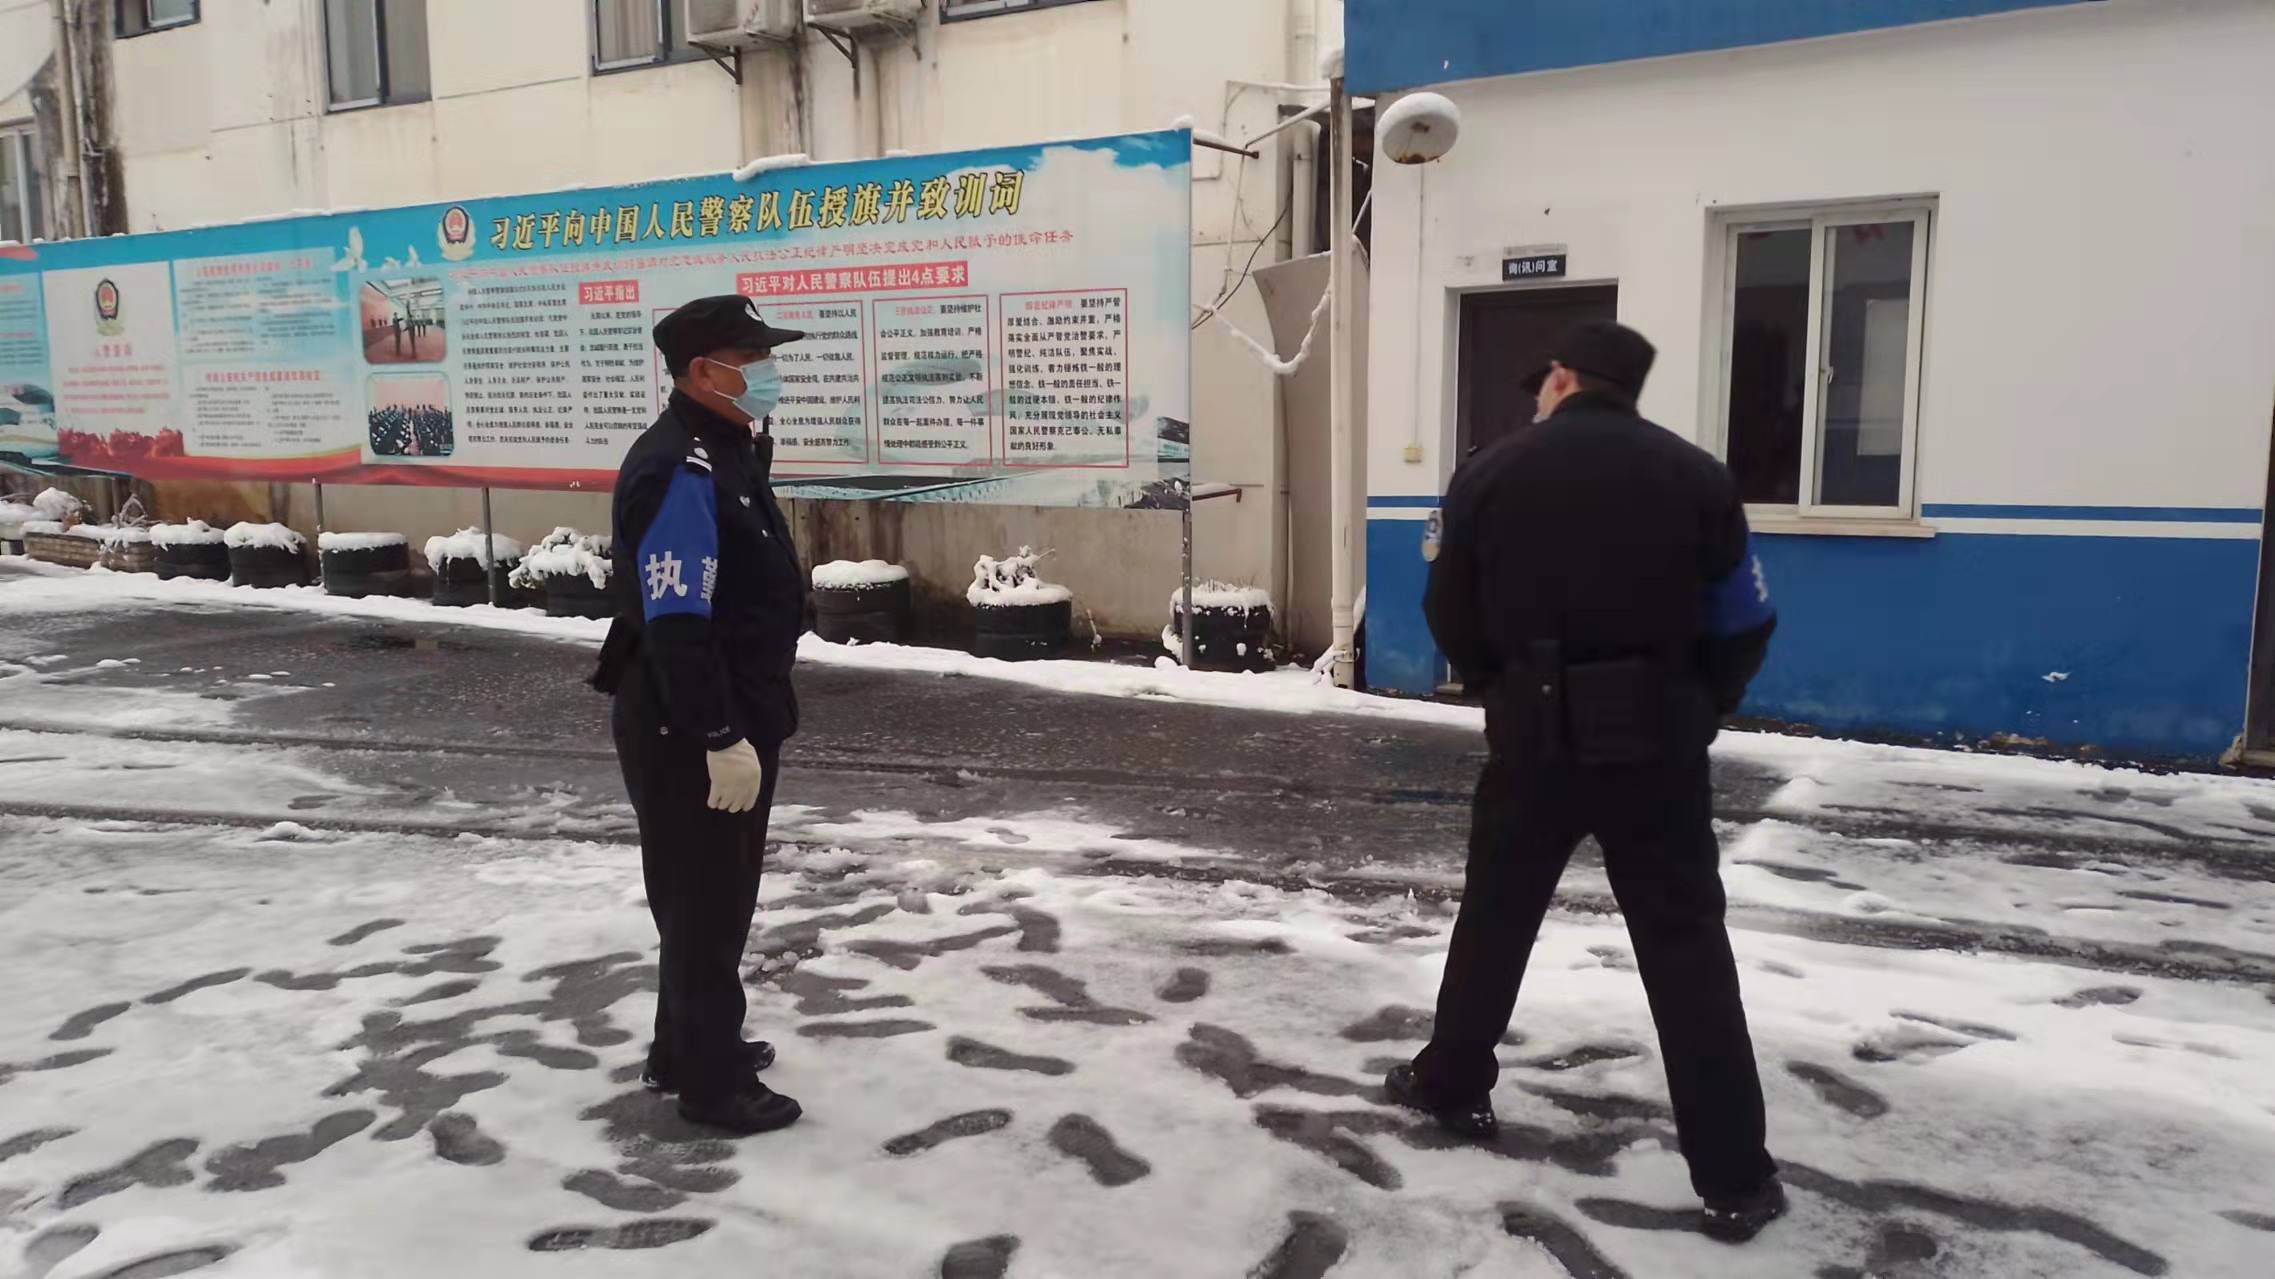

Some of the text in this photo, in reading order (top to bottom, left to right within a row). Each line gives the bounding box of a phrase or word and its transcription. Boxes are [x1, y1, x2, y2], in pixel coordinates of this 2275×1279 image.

[489, 170, 1025, 251] 习近平向中国人民警察队伍授旗并致训词
[742, 264, 966, 293] 习近平对人民警察队伍提出4点要求
[584, 285, 636, 302] 习近平指出
